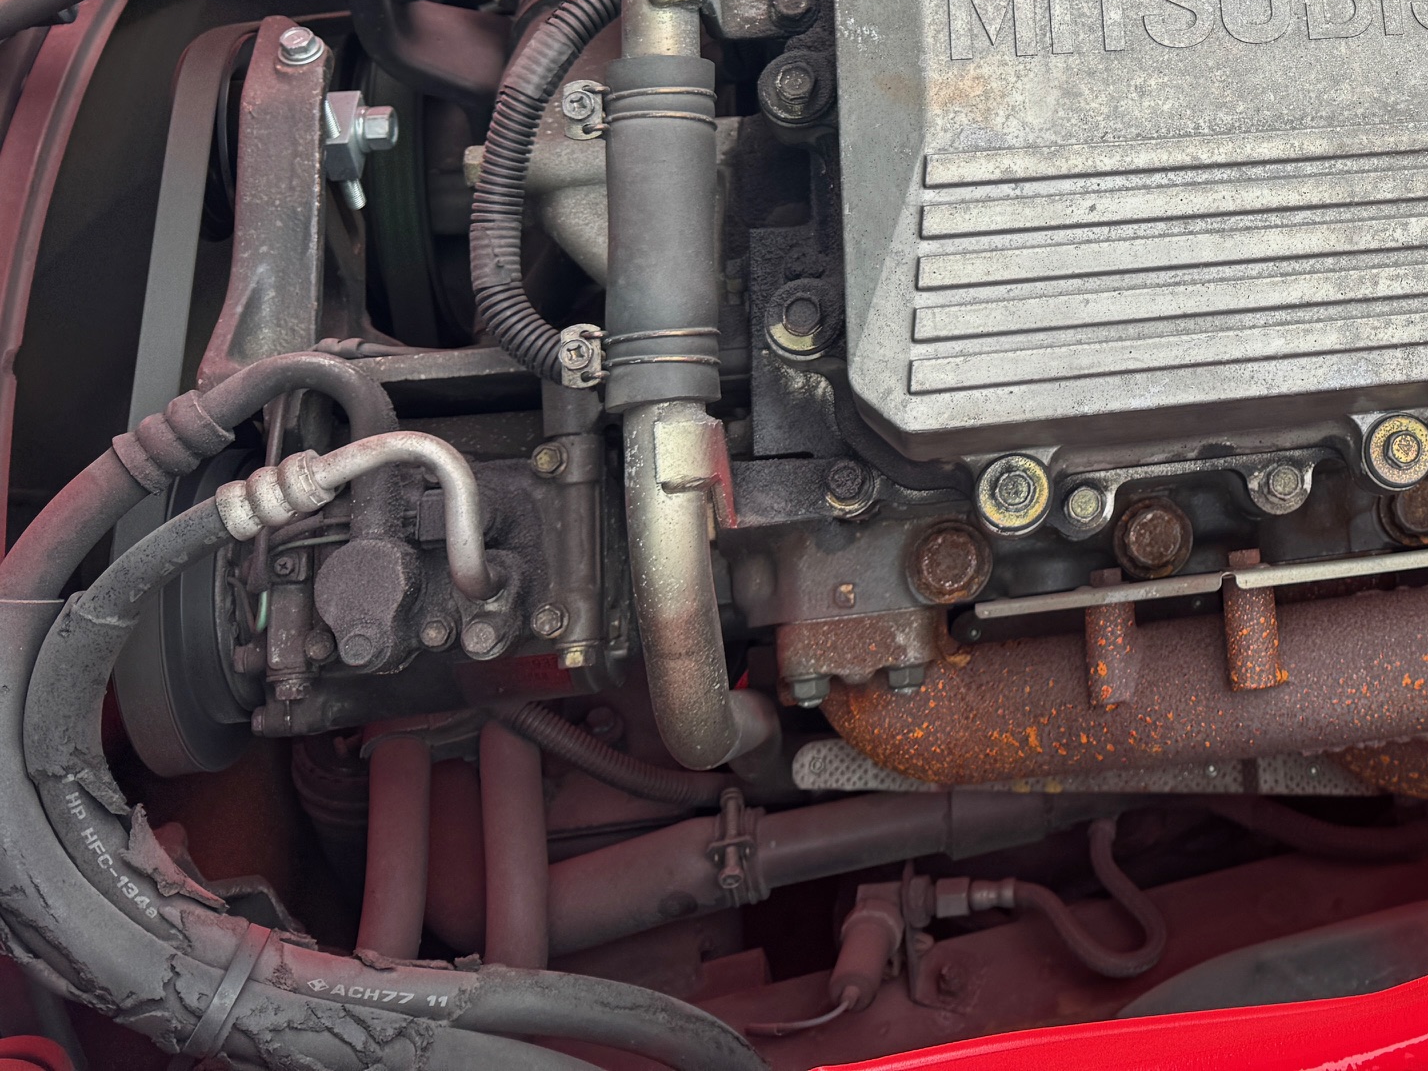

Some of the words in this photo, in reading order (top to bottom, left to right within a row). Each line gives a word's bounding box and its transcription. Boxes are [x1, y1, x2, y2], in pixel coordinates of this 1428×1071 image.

[65, 791, 87, 820] HP
[80, 826, 160, 919] HFC-134a
[330, 983, 415, 1005] ACH77
[426, 994, 449, 1008] 11
